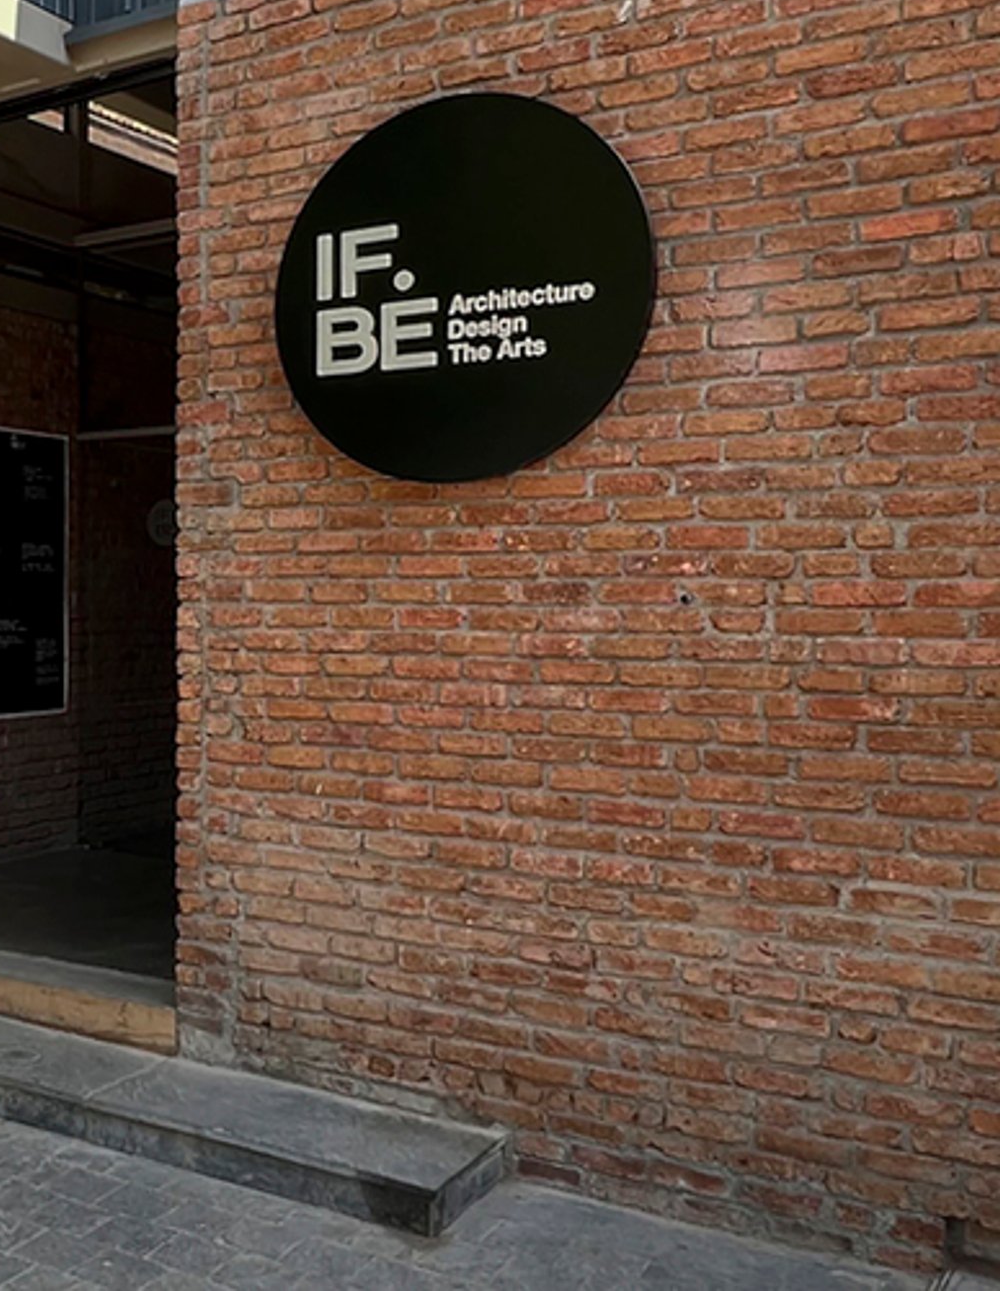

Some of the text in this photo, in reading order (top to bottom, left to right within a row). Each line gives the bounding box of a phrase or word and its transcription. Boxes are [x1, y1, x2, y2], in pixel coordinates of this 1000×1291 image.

[316, 223, 415, 301] IF.
[449, 281, 596, 316] Architecture
[316, 297, 439, 377] BE
[447, 314, 528, 340] Design
[447, 335, 547, 364] The Arts
